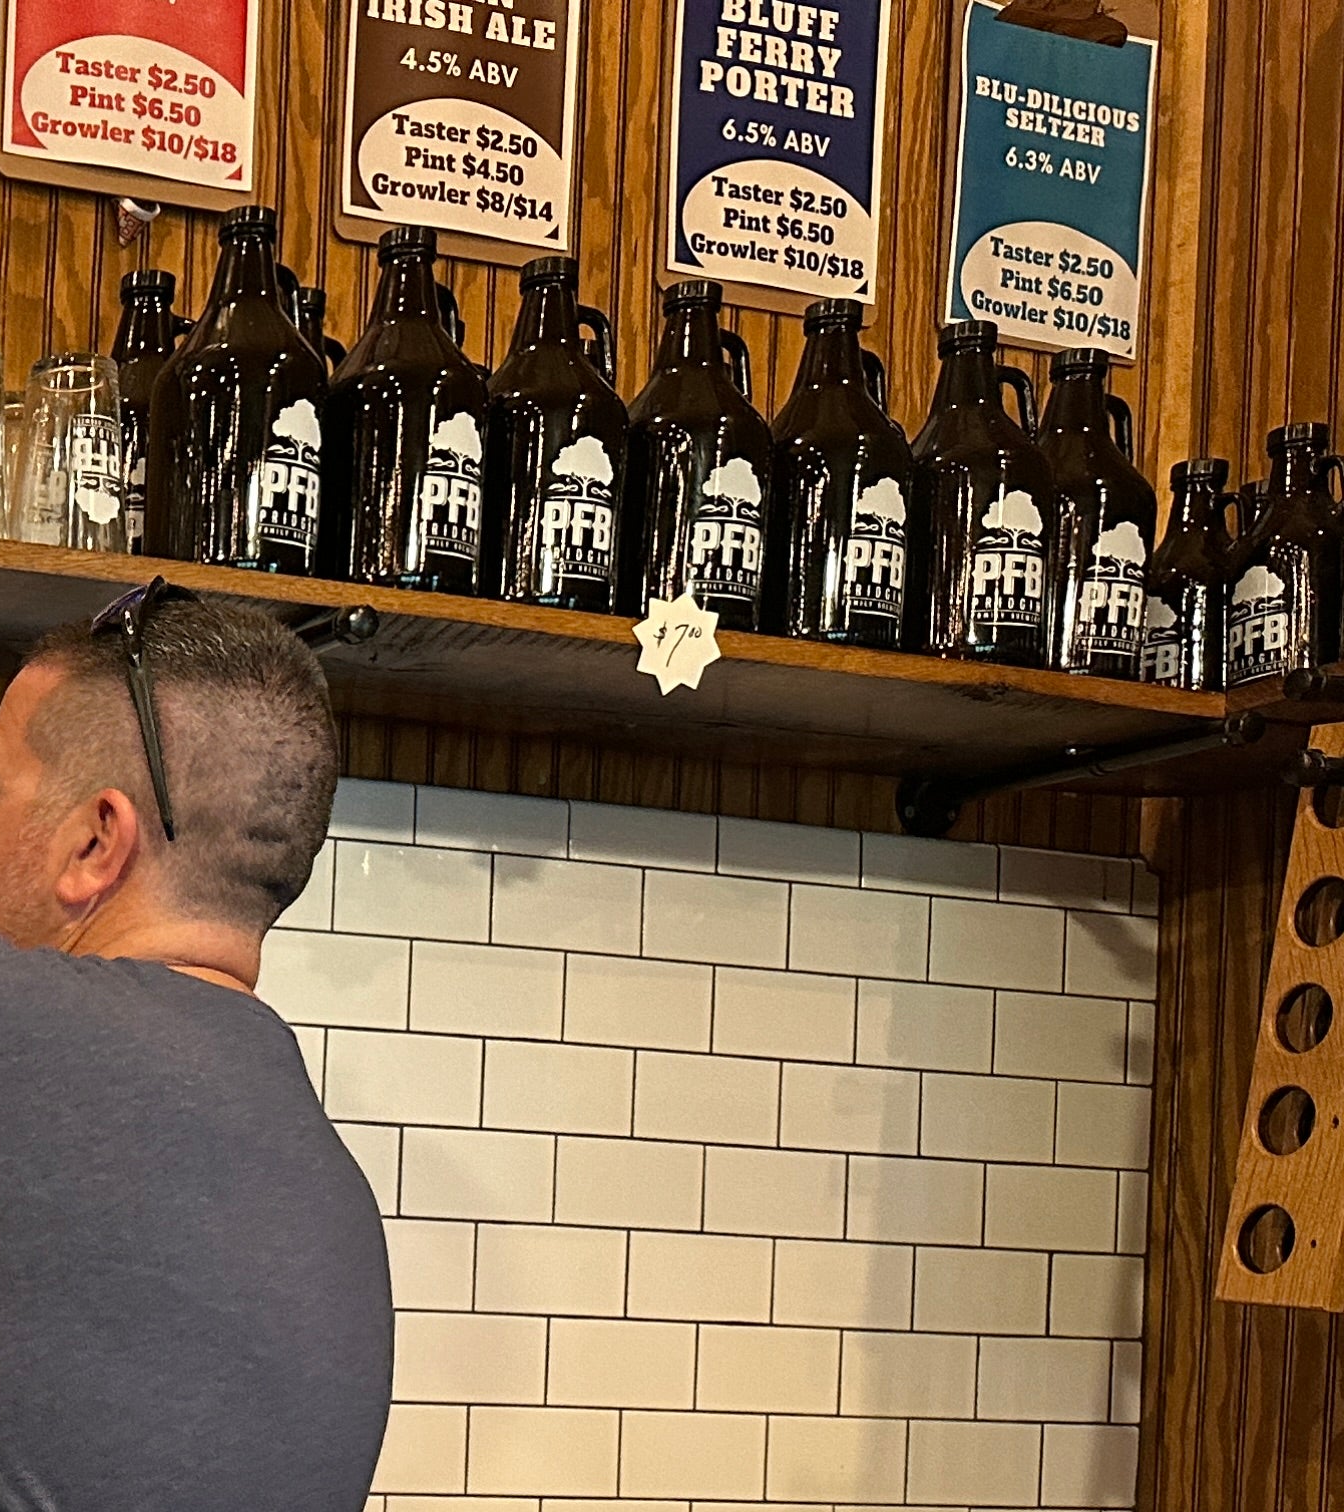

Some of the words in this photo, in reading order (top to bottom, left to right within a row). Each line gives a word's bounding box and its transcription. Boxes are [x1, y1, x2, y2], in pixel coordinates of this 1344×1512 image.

[367, 0, 473, 35] IRISH
[485, 11, 556, 51] ALE
[721, 0, 840, 42] BLUFF
[56, 51, 140, 83] Taster
[148, 63, 216, 98] $2.50
[400, 47, 462, 77] 4.5%
[469, 58, 519, 88] ABV
[716, 26, 842, 78] FERRY
[70, 84, 125, 112] Pint
[132, 91, 201, 127] $6.50
[699, 60, 855, 118] PORTER
[975, 75, 1141, 133] BLU-DILICIOUS
[32, 111, 135, 144] Growler
[141, 124, 237, 164] $10/$18
[392, 113, 471, 144] Taster
[476, 124, 538, 158] $2.50
[722, 118, 777, 147] 6.5%
[783, 129, 831, 158] ABV
[1005, 107, 1106, 148] SELTZER
[405, 145, 456, 173] Pint
[462, 152, 524, 186] $4.50
[1005, 146, 1053, 174] 6.3%
[1058, 158, 1102, 185] ABV
[372, 173, 471, 206] Growler
[476, 185, 553, 222] $8/$14
[712, 175, 784, 206] Taster
[790, 186, 847, 219] $2.50
[723, 207, 771, 234] Pint
[776, 213, 834, 246] $6.50
[690, 233, 779, 264] Growler
[783, 245, 864, 280] $10/$18
[990, 236, 1054, 267] Taster
[1058, 249, 1114, 280] $2.50
[1001, 267, 1043, 295] Pint
[1048, 276, 1104, 307] $6.50
[971, 289, 1048, 325] Growler
[1053, 308, 1130, 341] $10/$18
[260, 461, 321, 520] PFB
[419, 475, 481, 530] PFB
[420, 522, 479, 545] RIDGI
[540, 501, 612, 552] PFB
[690, 521, 761, 571] PFB
[843, 539, 904, 590] PFB
[971, 553, 1042, 599] PFB
[1078, 581, 1144, 628] PFB
[1229, 612, 1289, 661] PFB
[1140, 643, 1180, 681] FB
